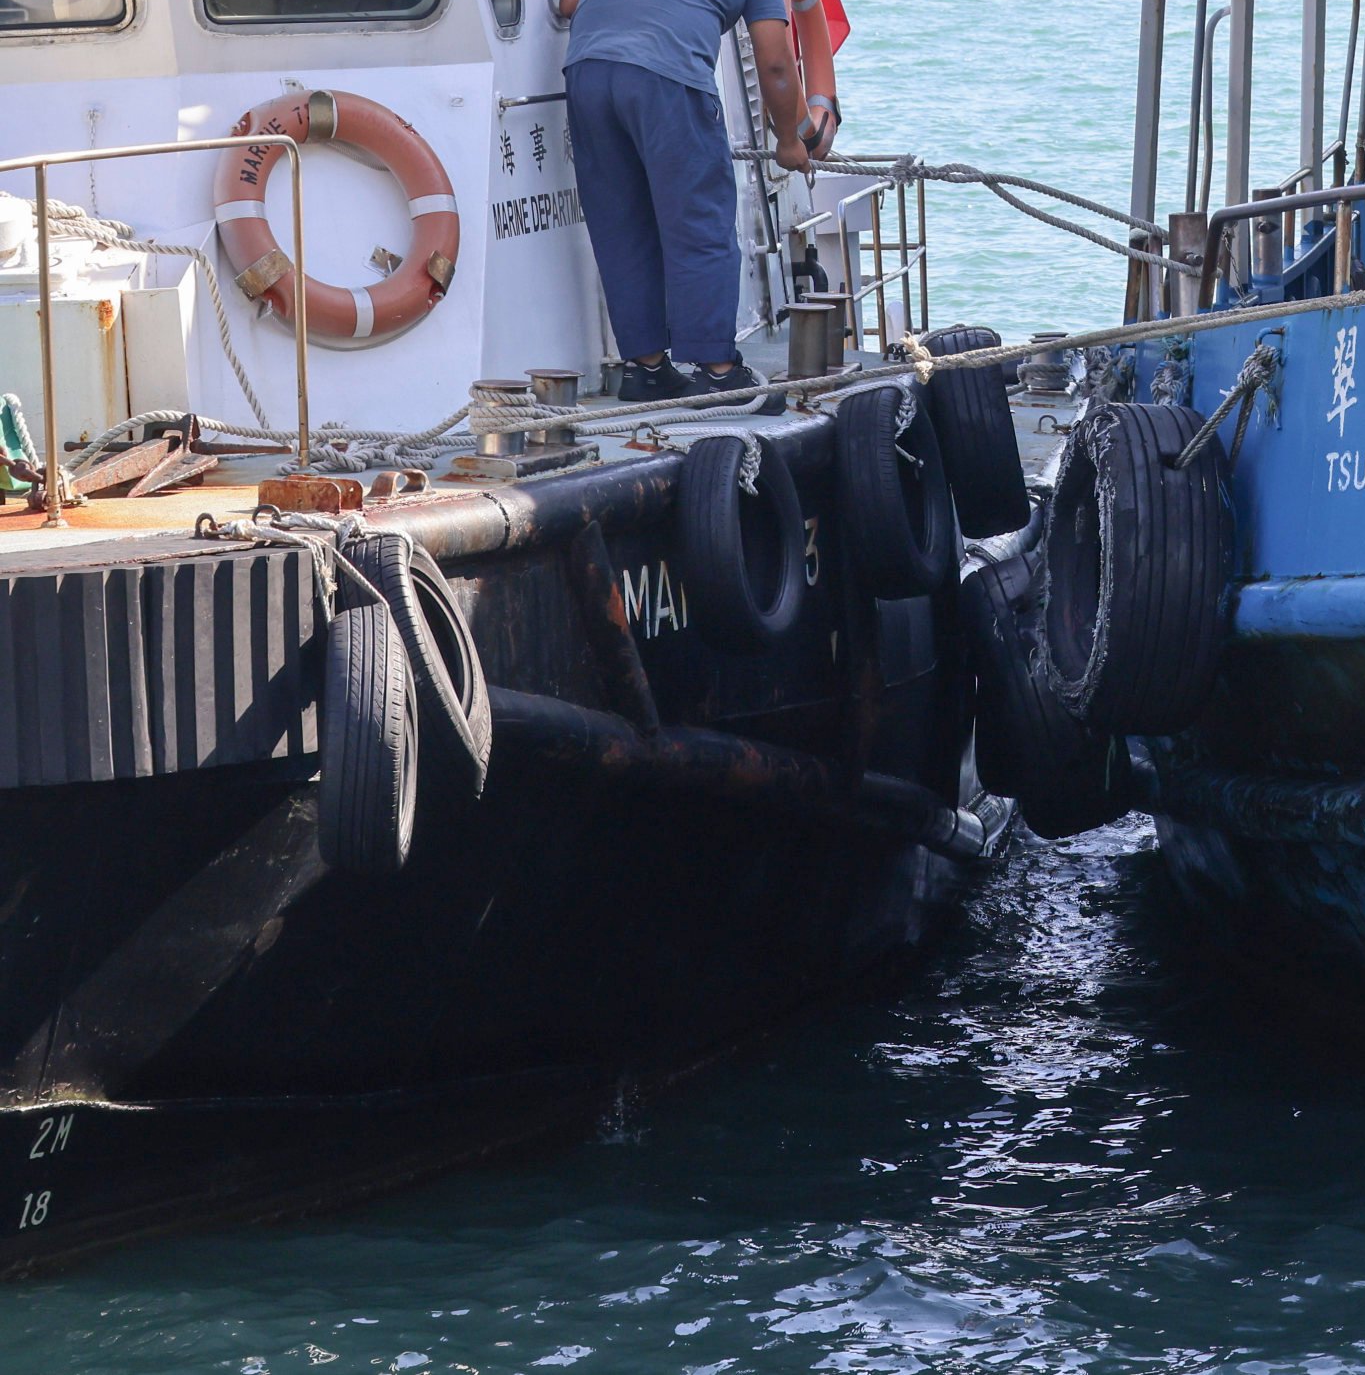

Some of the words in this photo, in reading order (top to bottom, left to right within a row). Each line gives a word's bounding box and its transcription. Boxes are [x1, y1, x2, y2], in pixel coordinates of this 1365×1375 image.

[492, 197, 531, 240] MARINE
[29, 1113, 74, 1160] 2M
[18, 1190, 52, 1230] 18
